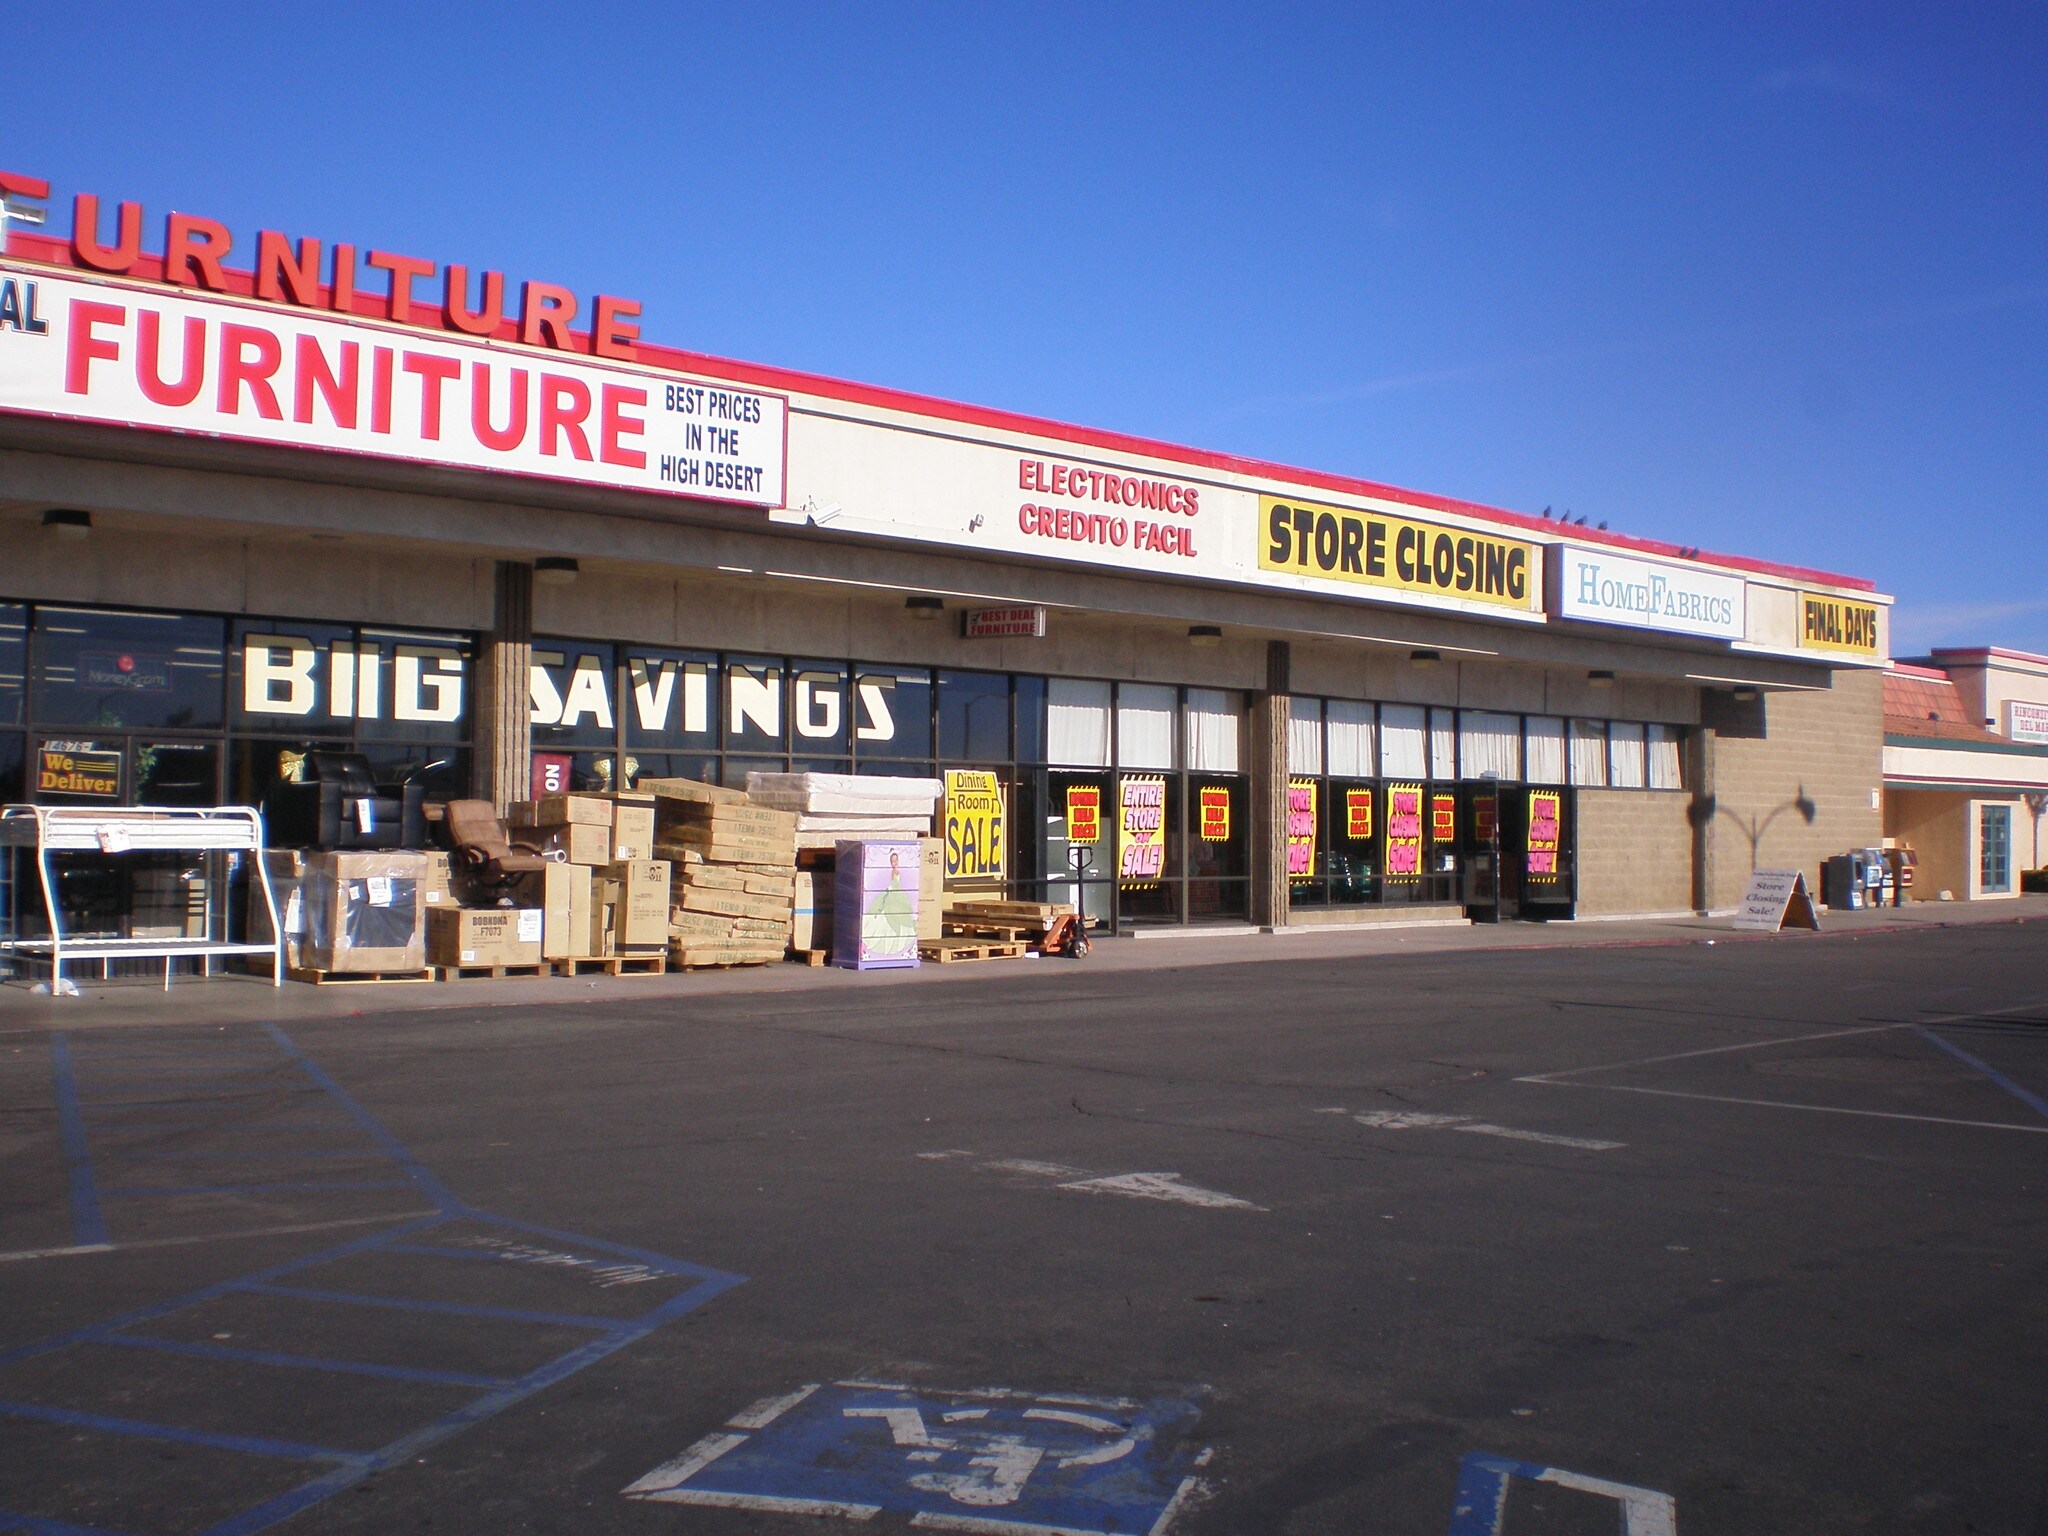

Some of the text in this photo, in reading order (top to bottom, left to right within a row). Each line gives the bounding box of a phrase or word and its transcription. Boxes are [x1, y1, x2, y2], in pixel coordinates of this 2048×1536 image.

[0, 171, 641, 360] FURNITURE
[64, 298, 648, 469] FURNITURE
[666, 384, 761, 424] BEST PRICES
[686, 422, 739, 456] IN THE
[661, 454, 763, 493] HIGH DESERT
[1019, 459, 1199, 516] ELECTRONICS
[1019, 503, 1198, 558] CREDITO FACIL
[1269, 504, 1526, 600] STORE CLOSING
[981, 609, 1036, 621] BEST DEAL
[1805, 600, 1877, 648] FINAL DAYS
[971, 623, 1036, 635] FURNITURE
[530, 651, 896, 741] SAVINGS
[44, 753, 75, 771] We
[41, 772, 116, 793] Deliver
[956, 772, 988, 789] Dining
[957, 794, 990, 810] Room
[1122, 784, 1163, 807] ENTIRE
[1289, 788, 1311, 812] TORE
[1124, 807, 1162, 831] STORE
[1289, 811, 1314, 837] OSING
[947, 817, 1002, 875] SALE
[1135, 832, 1152, 843] ON
[1120, 844, 1163, 878] SALE!
[1755, 881, 1785, 891] Store
[1746, 893, 1786, 905] Closing
[480, 927, 502, 936] F7073
